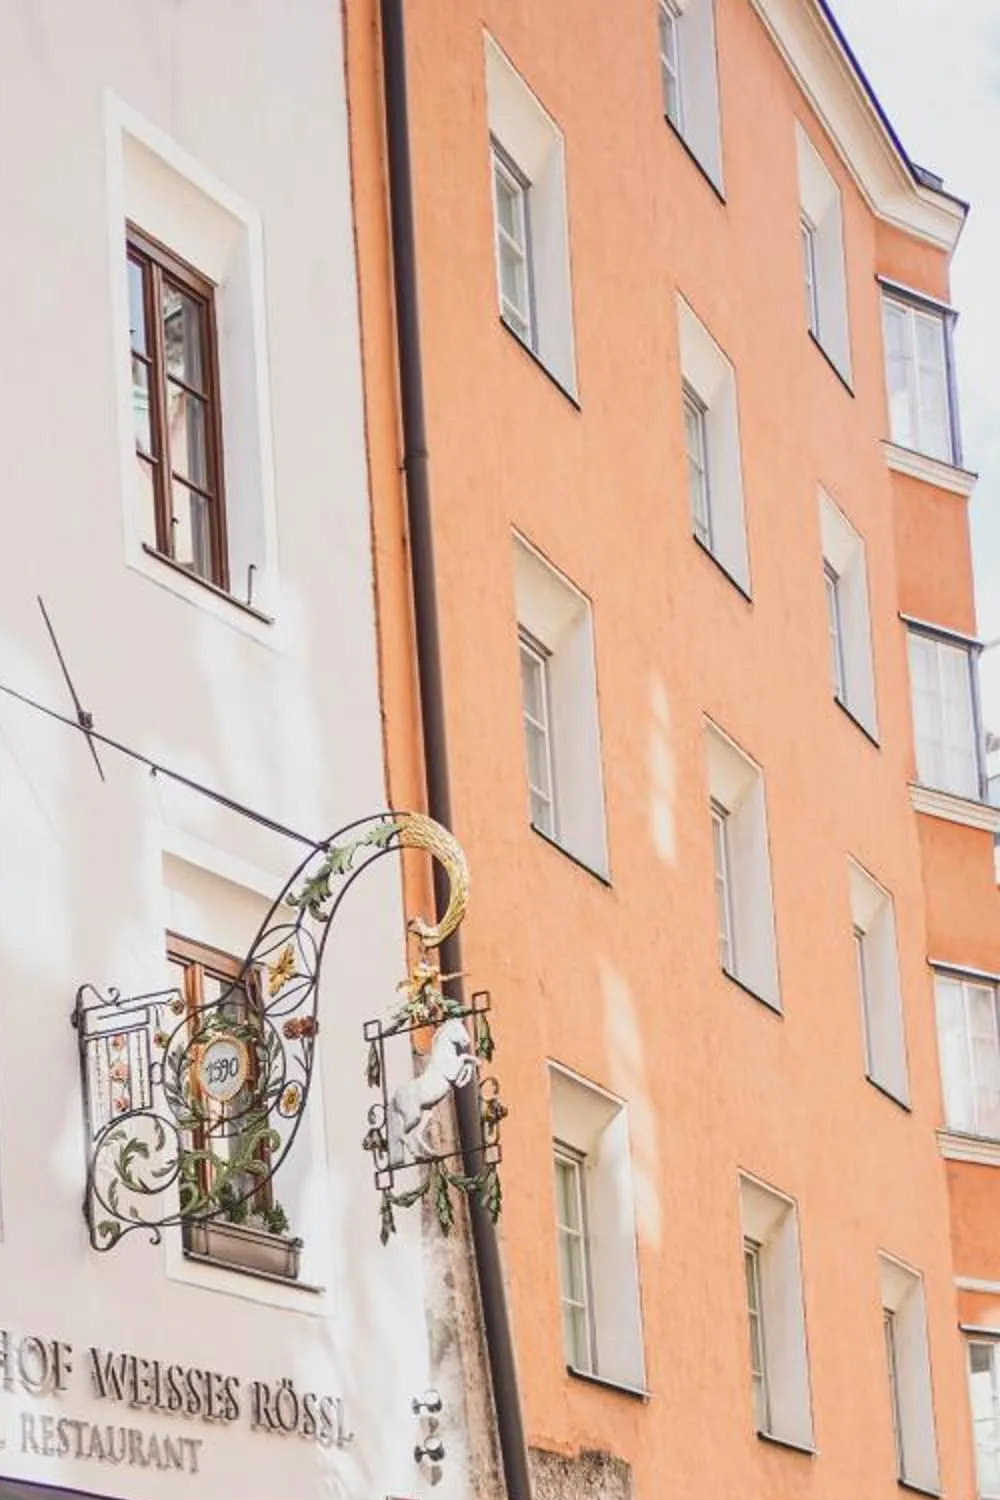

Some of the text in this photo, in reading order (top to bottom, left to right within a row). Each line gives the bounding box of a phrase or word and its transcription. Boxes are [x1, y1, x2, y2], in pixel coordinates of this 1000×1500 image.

[205, 1057, 238, 1084] 1590
[88, 1347, 241, 1423] WEISSES
[251, 1377, 355, 1447] RÖSSL
[19, 1411, 204, 1474] RESTAURANT
